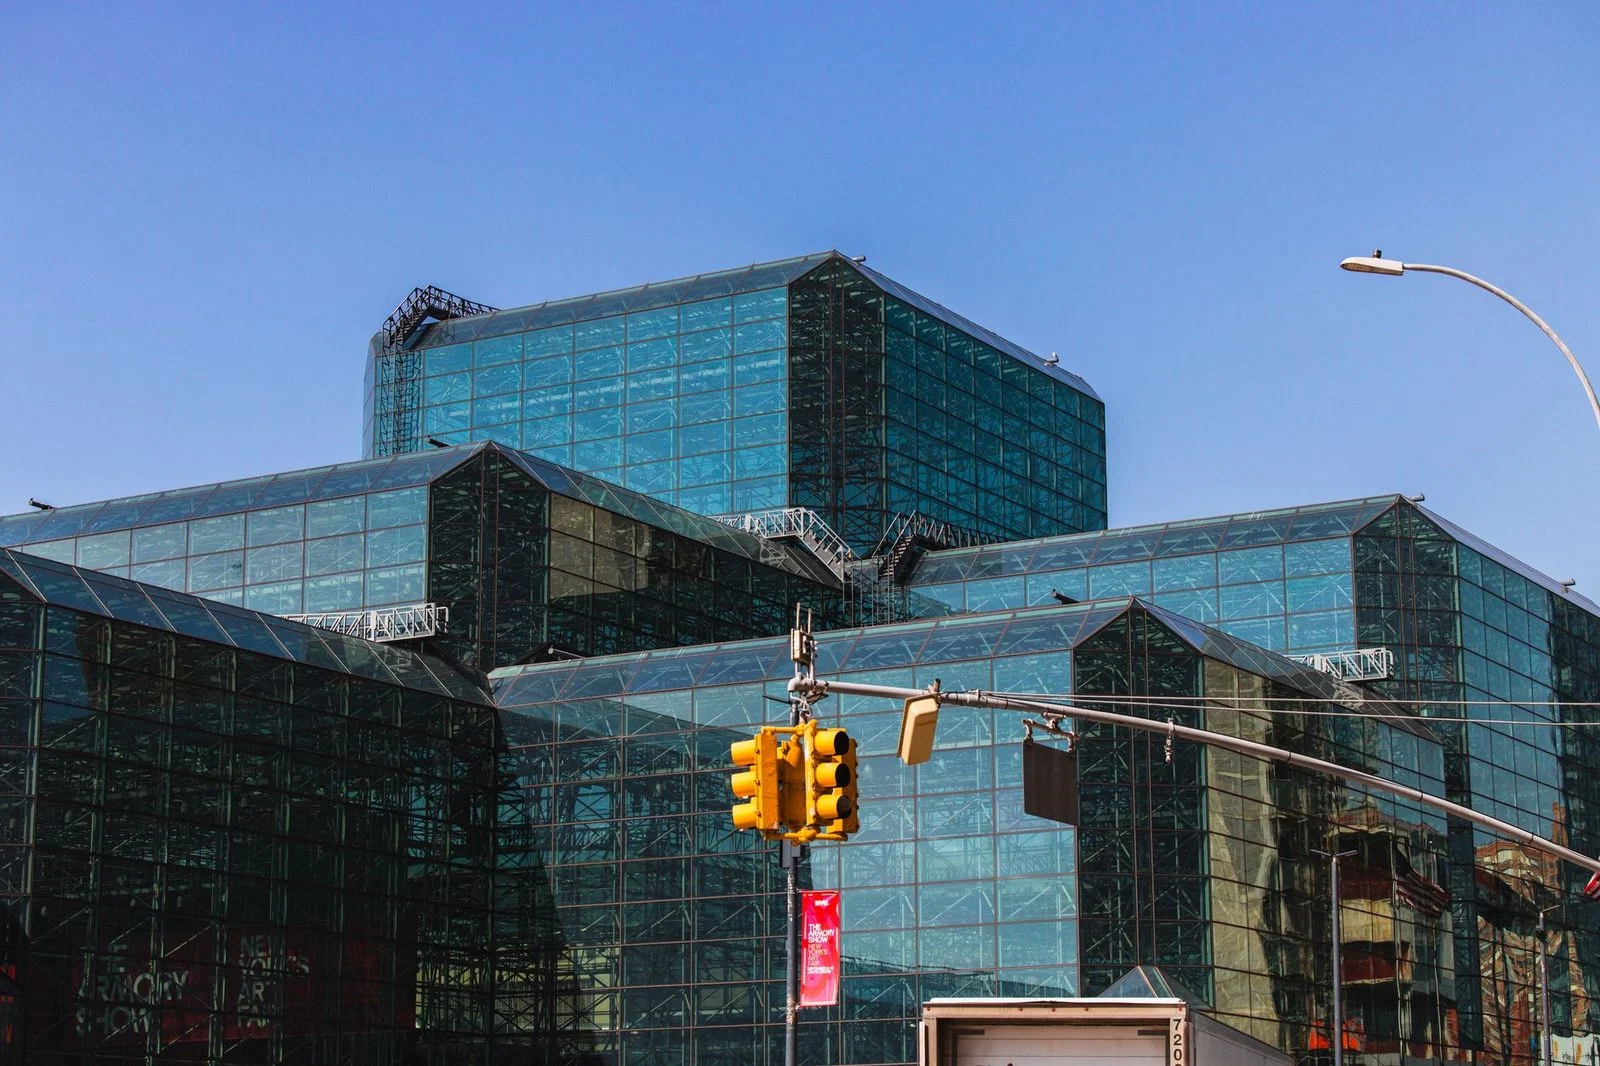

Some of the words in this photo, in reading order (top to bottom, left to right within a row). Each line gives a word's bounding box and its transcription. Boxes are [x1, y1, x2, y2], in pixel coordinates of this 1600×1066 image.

[808, 923, 822, 931] THE
[808, 929, 835, 937] ARMORY
[1173, 1019, 1182, 1066] 720
